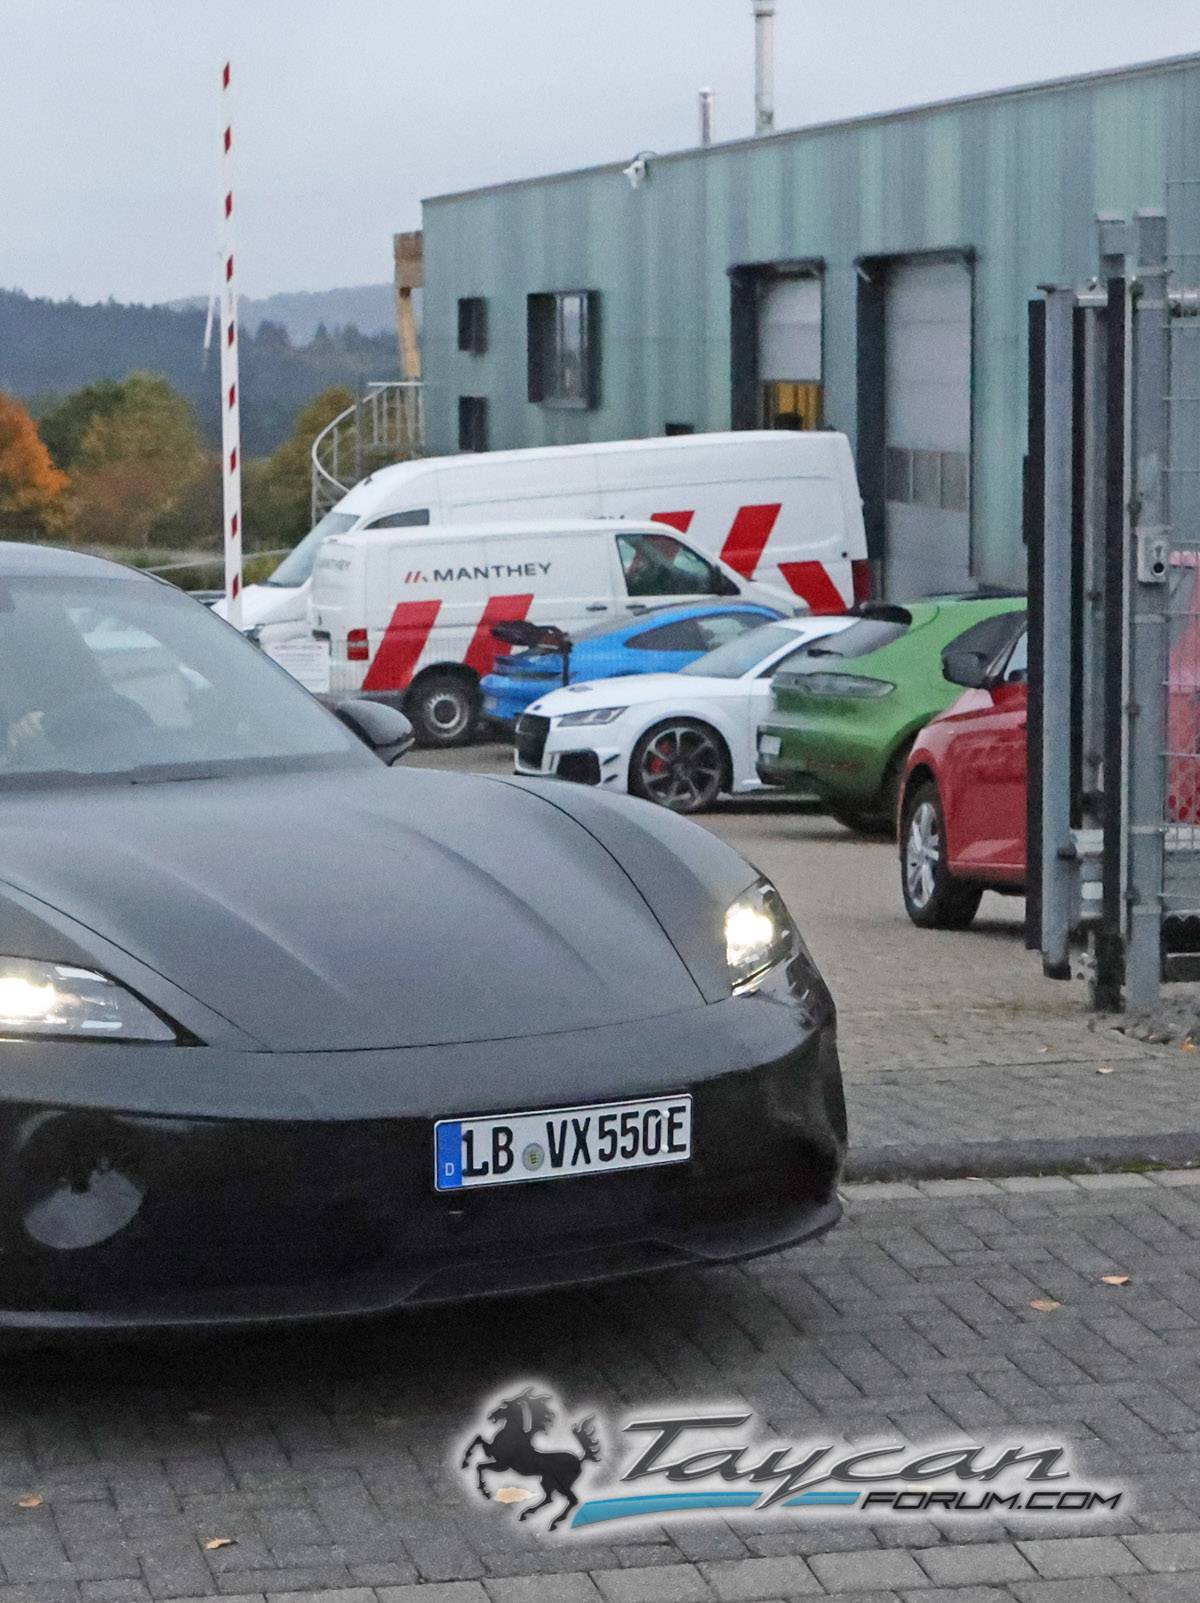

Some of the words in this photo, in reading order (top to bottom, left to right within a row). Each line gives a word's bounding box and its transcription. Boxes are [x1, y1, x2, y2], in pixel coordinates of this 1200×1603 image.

[433, 562, 552, 582] MANTHEY
[546, 1105, 687, 1168] VX550E
[445, 1162, 455, 1176] D
